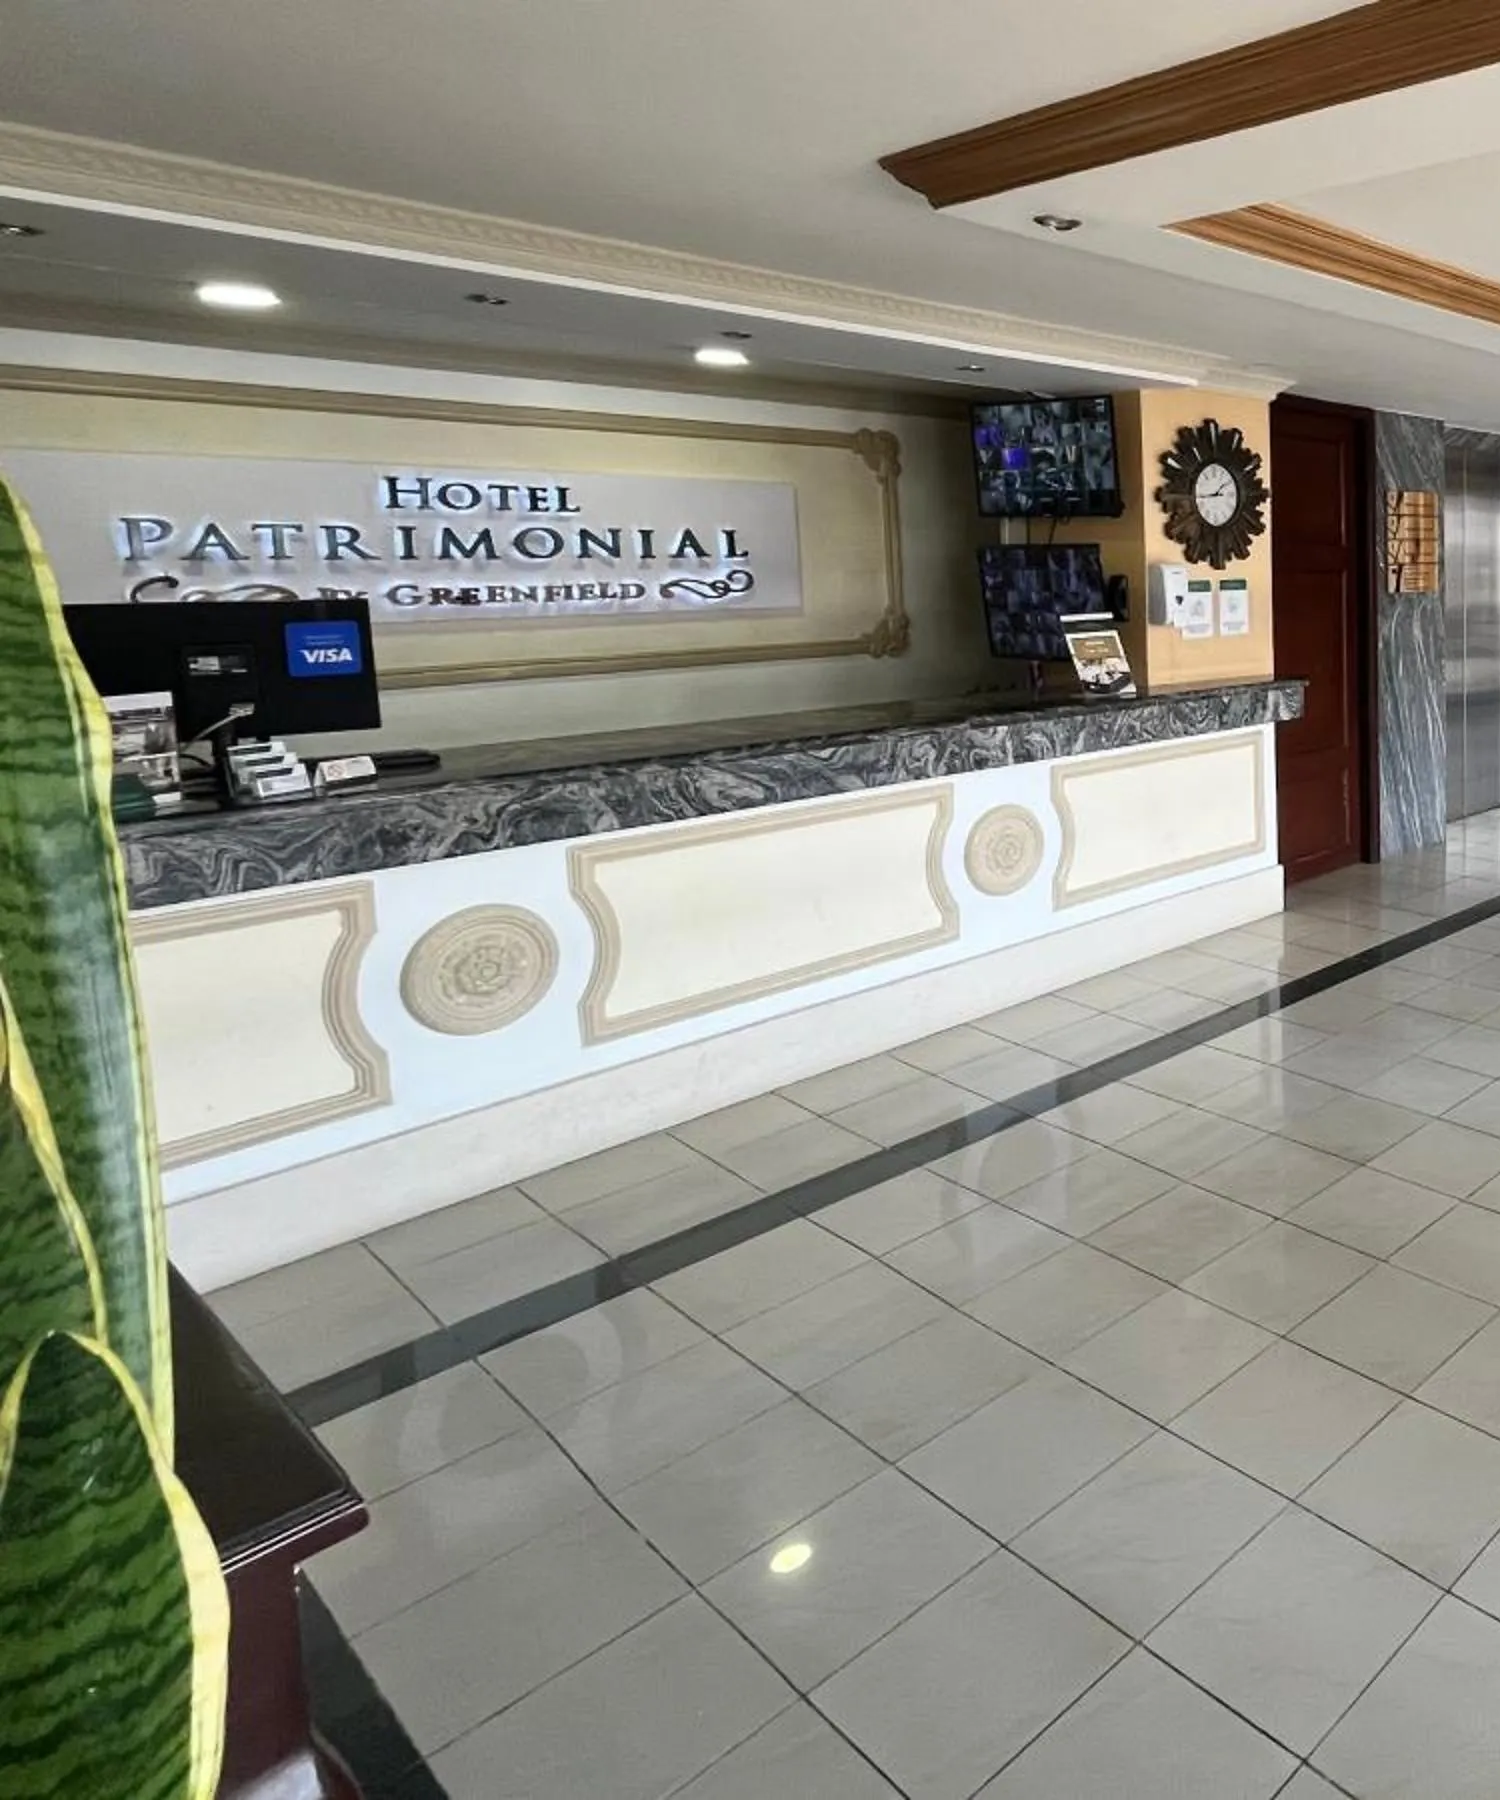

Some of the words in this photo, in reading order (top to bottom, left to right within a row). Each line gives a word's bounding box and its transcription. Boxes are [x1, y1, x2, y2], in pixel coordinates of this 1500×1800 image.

[383, 475, 581, 513] HOTEL
[119, 517, 749, 561] PATRIMONIAL
[385, 581, 646, 607] GREENFIELD
[299, 647, 353, 664] VISA
